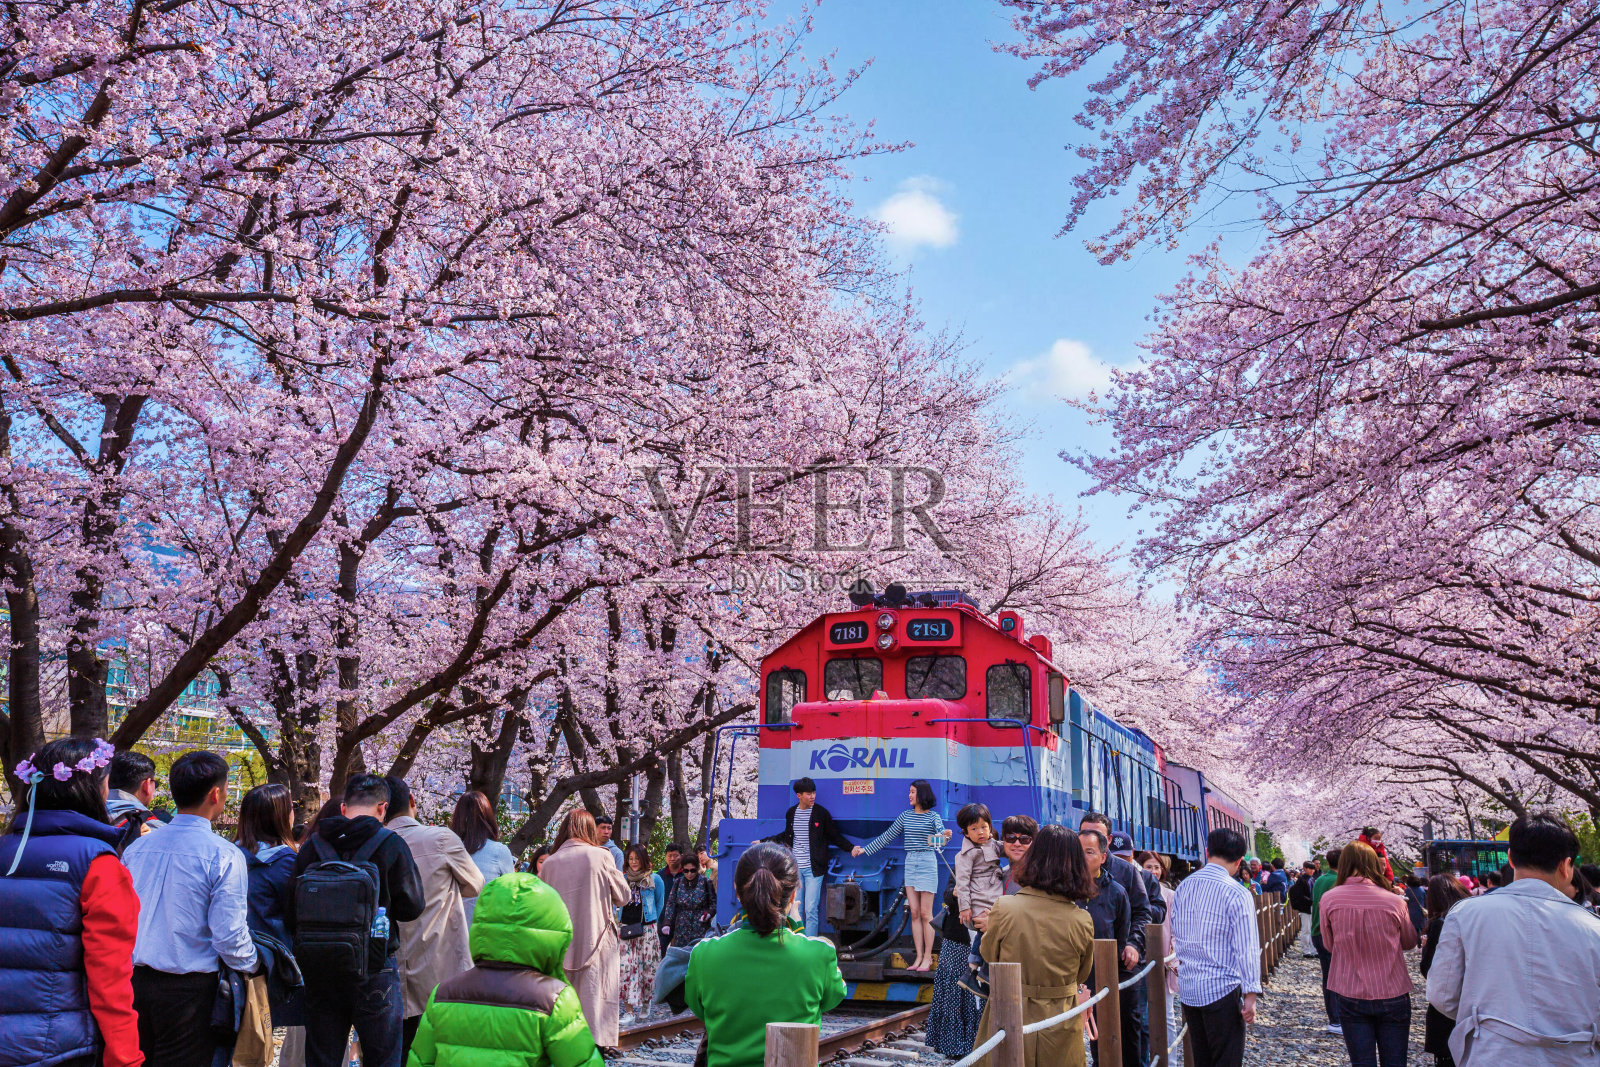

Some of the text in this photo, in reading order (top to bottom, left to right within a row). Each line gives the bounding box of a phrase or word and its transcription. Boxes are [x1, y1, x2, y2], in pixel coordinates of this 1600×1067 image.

[834, 626, 863, 640] 7181
[912, 623, 947, 636] 7181
[809, 743, 914, 772] KORAIL
